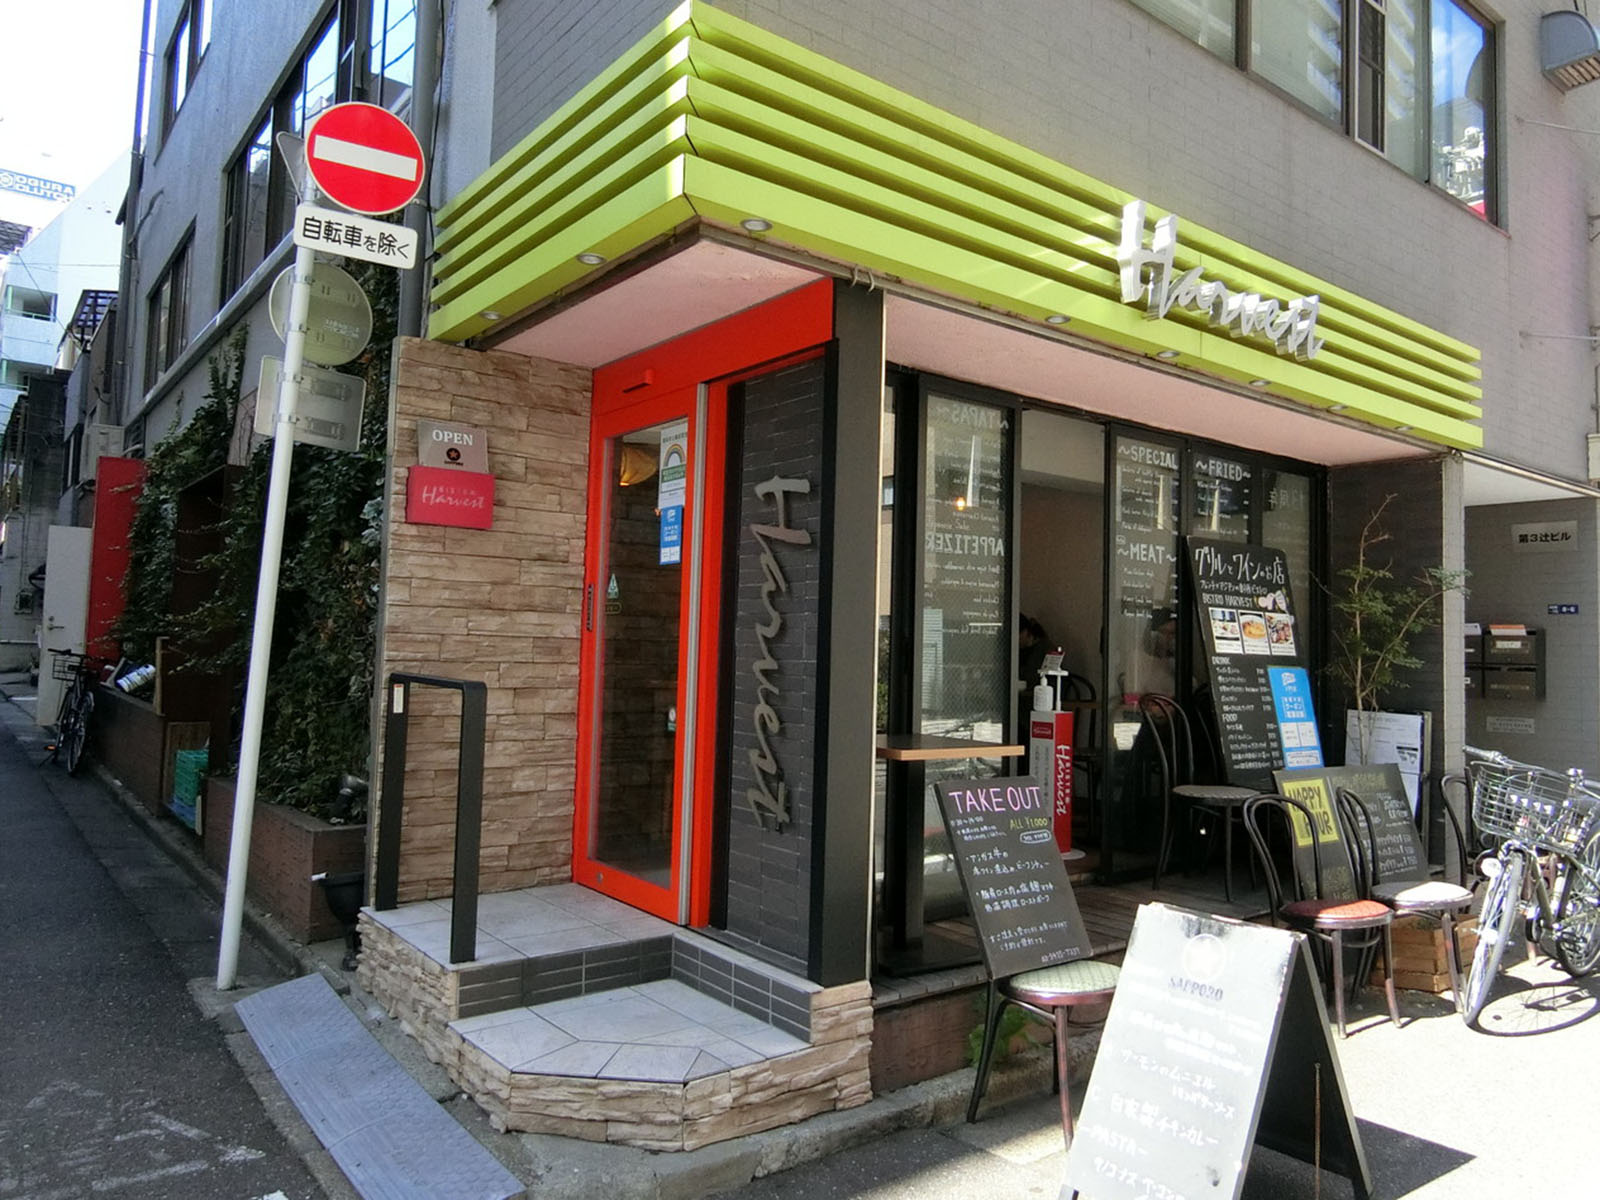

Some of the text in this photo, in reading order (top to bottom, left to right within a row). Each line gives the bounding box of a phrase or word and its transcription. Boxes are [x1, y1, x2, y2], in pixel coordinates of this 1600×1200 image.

[15, 174, 74, 196] OGURA
[303, 215, 410, 260] 自転車を除く
[1116, 199, 1325, 362] Harvest
[432, 428, 474, 447] OPEN
[421, 485, 486, 509] Harvest
[746, 473, 813, 836] Harvest
[948, 786, 1041, 814] TAKE OUT
[1009, 819, 1026, 830] ALL
